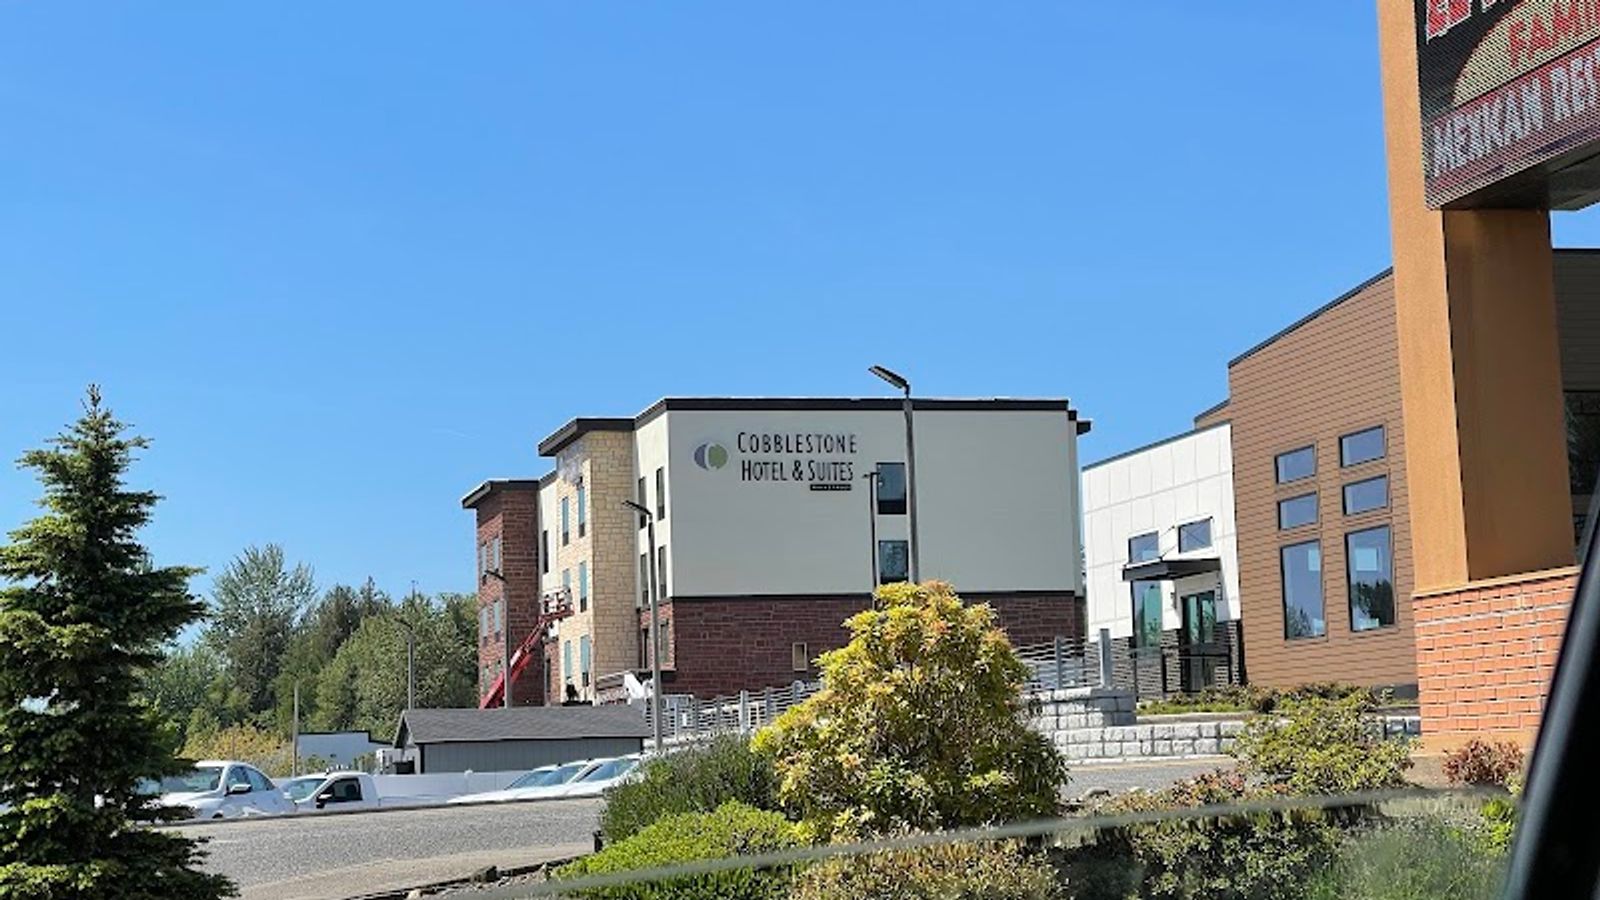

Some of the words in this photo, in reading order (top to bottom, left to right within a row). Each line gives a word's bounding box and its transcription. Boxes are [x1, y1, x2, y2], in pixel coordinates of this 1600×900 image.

[1550, 47, 1600, 122] RES
[737, 431, 857, 454] COBBLESTONE
[741, 459, 788, 482] HOTEL
[792, 459, 804, 482] &
[808, 459, 854, 482] SUITES
